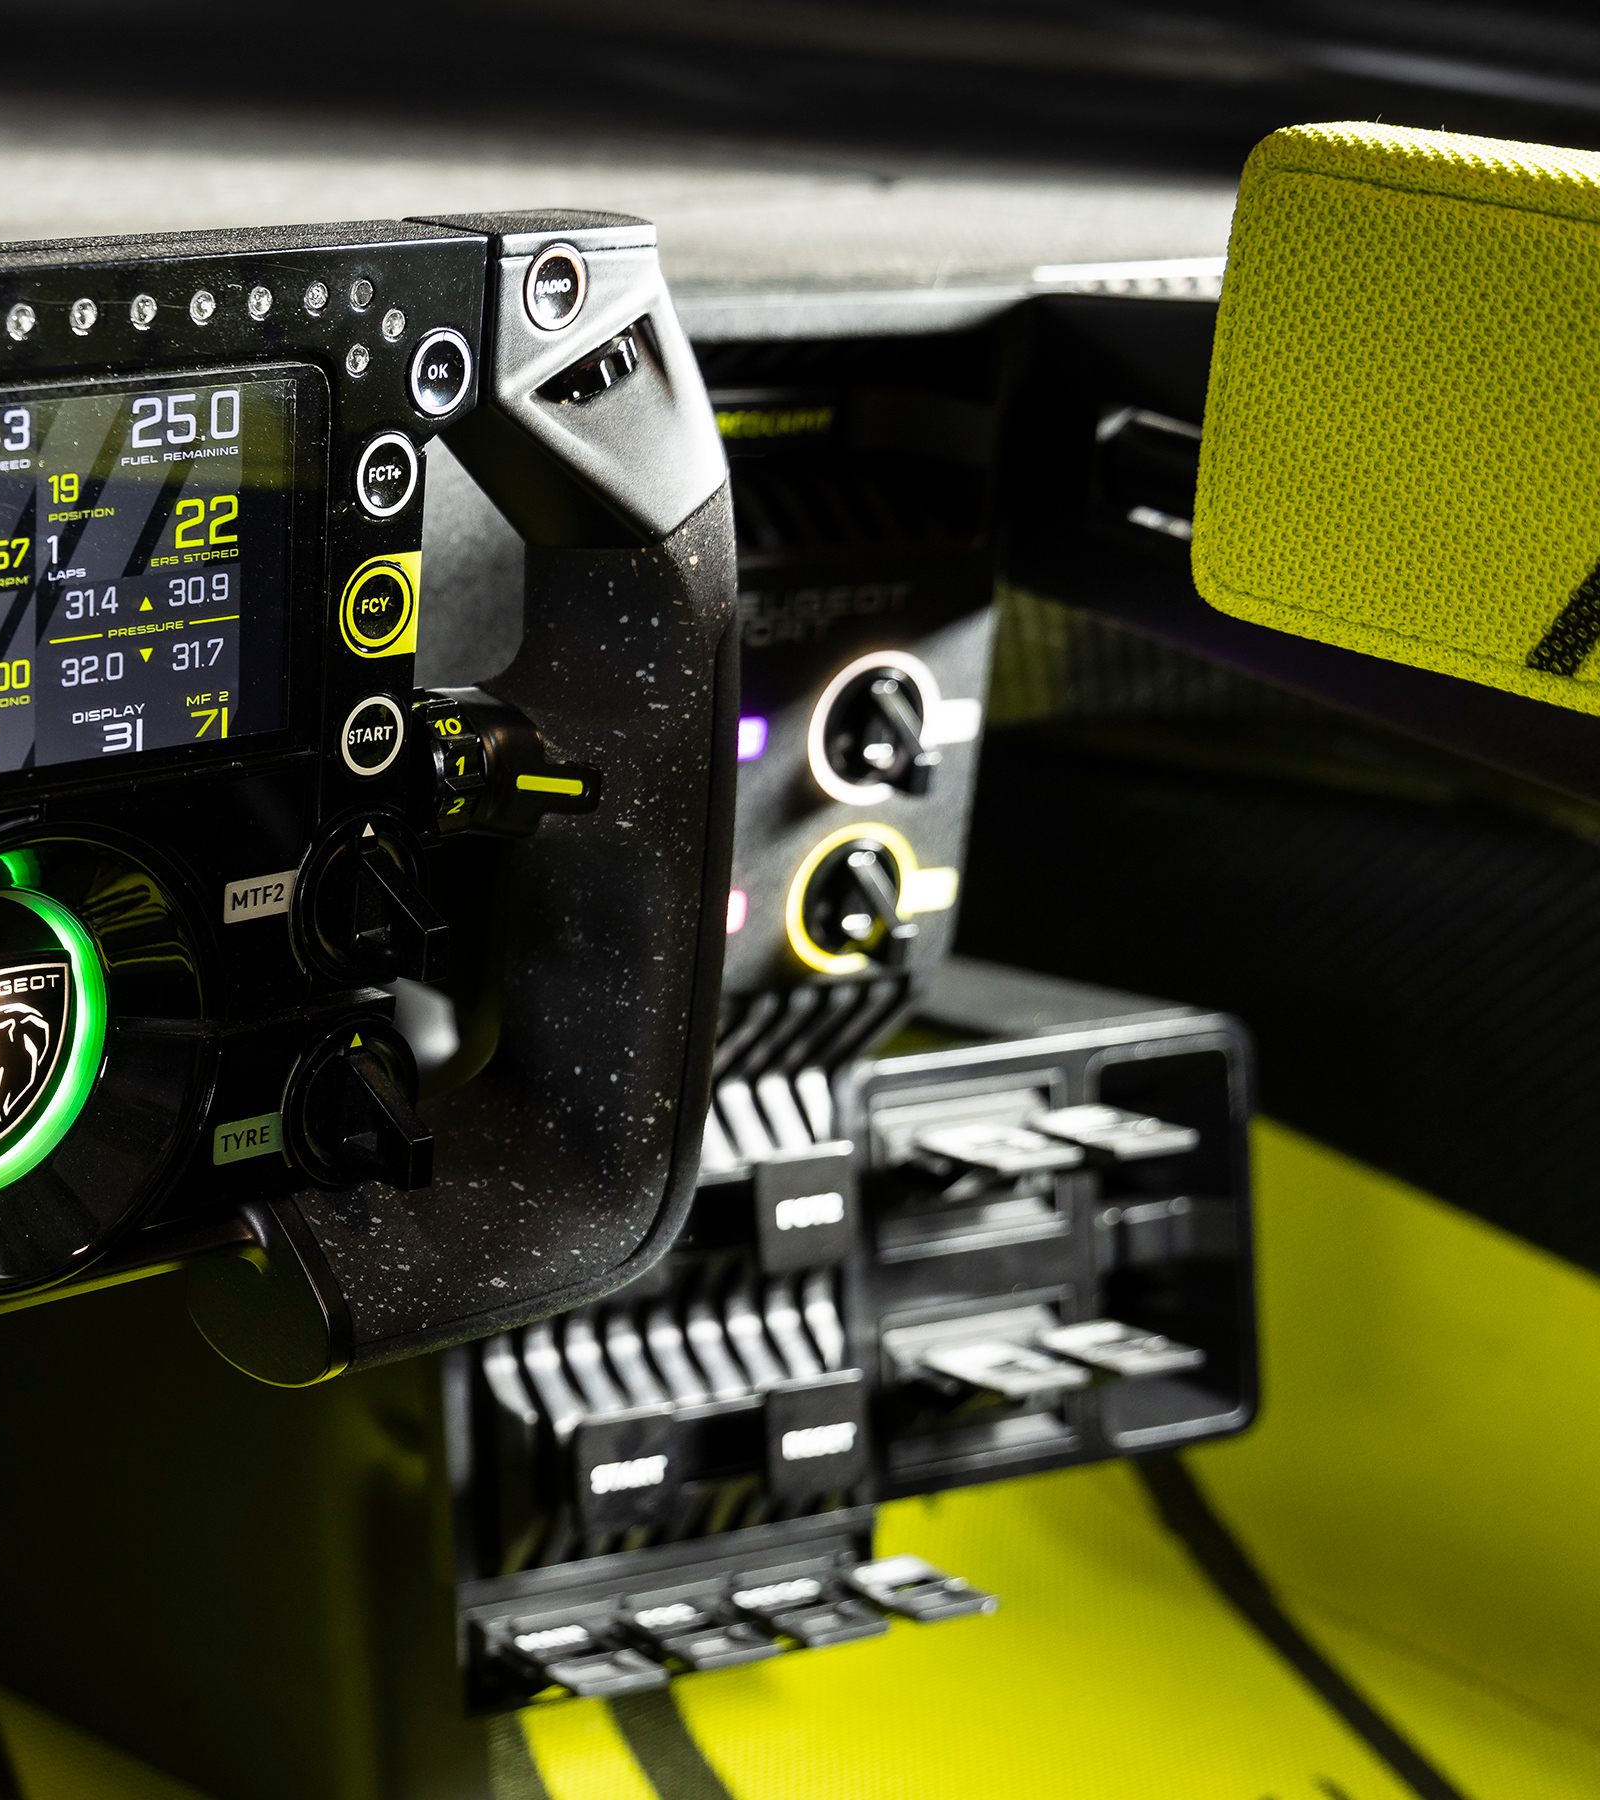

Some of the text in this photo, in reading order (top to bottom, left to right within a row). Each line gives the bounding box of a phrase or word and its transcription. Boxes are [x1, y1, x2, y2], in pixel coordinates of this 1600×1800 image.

[535, 278, 571, 295] RADIO
[427, 363, 449, 380] OK
[131, 390, 240, 449] 25.0
[121, 445, 239, 467] FUEL REMAINING
[368, 464, 402, 482] FCT+
[48, 473, 80, 504] 19
[48, 507, 115, 523] POSITION
[175, 495, 239, 550] 22
[47, 535, 59, 565] 1
[150, 548, 239, 568] ERS STORED
[47, 568, 87, 582] LAPS
[168, 573, 229, 607] 30.9
[65, 586, 119, 620] 31.4
[361, 596, 391, 614] FCY
[108, 620, 184, 638] PRESSURE
[172, 638, 225, 671] 31.7
[61, 652, 124, 688] 32.0
[186, 691, 230, 707] MF 2
[72, 703, 145, 724] DISPLAY
[191, 707, 229, 739] 71
[102, 718, 144, 752] 31
[347, 725, 394, 745] START
[434, 717, 462, 736] 10
[455, 756, 466, 776] 1
[446, 797, 466, 815] 2
[231, 883, 286, 911] MTF2
[220, 1125, 271, 1153] TYRE
